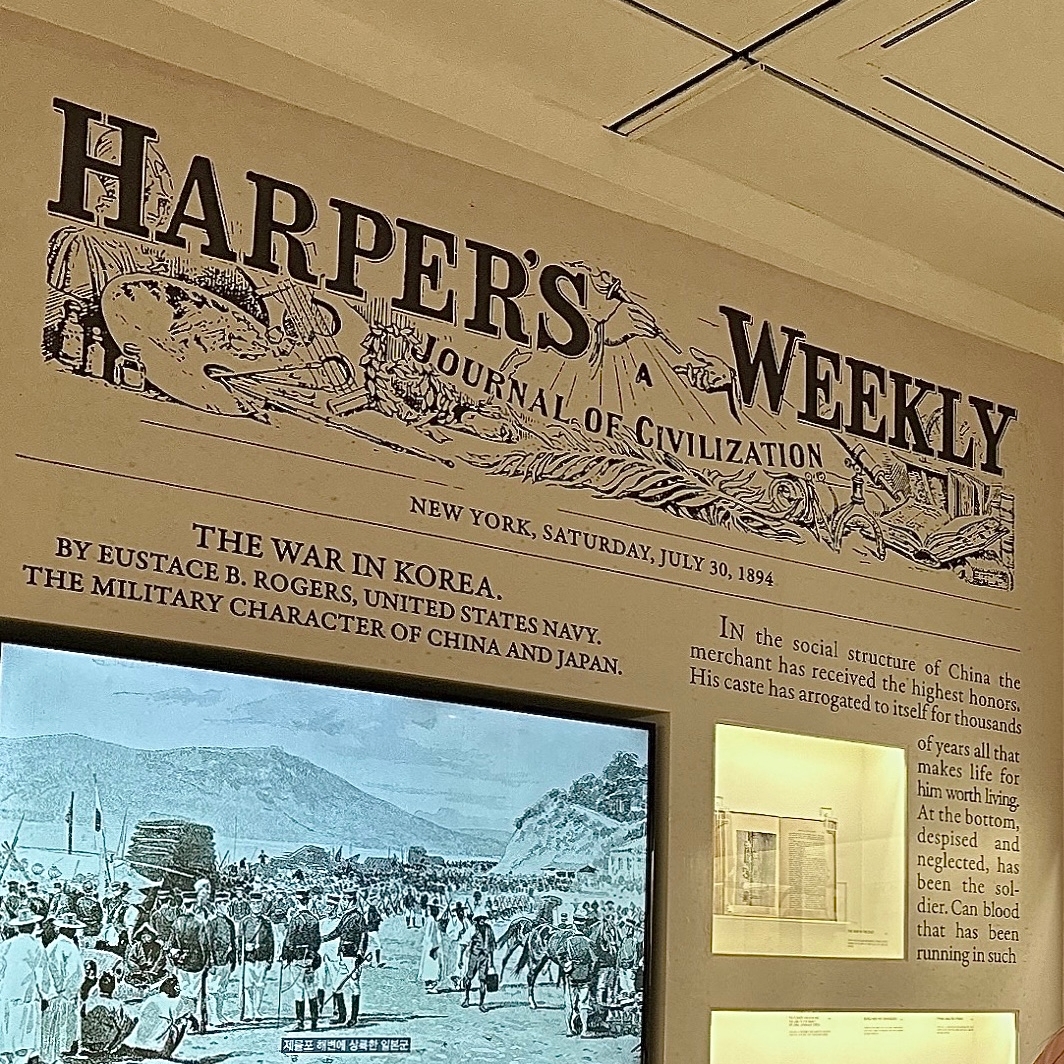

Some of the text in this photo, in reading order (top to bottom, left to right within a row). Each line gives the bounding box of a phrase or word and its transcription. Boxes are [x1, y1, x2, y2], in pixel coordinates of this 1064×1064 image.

[48, 97, 1017, 477] HARPER'S WEEKLY
[411, 333, 824, 469] JOURNAL OF CIVILIZATION
[636, 362, 653, 388] A
[192, 522, 503, 601] THE WAR IN KOREA.
[409, 495, 774, 587] NEW YORK, SATURDAY, JULY 30, 1894
[22, 564, 623, 676] THE MILITARY CHARACTER OF CHINA AND JAPAN.
[54, 536, 602, 646] BY EUSTACE B. ROGERS, UNITED STATES NAVY.
[689, 645, 1021, 713] merchant has received the highest honors.
[755, 627, 783, 648] the
[792, 639, 838, 658] social
[847, 649, 917, 672] structure
[924, 659, 942, 677] of
[948, 663, 991, 686] China
[999, 671, 1021, 690] the
[917, 759, 1020, 786] makes life for
[917, 779, 1020, 813] him worth living.
[916, 804, 1020, 830] At the bottom,
[380, 1039, 409, 1051] 일본군
